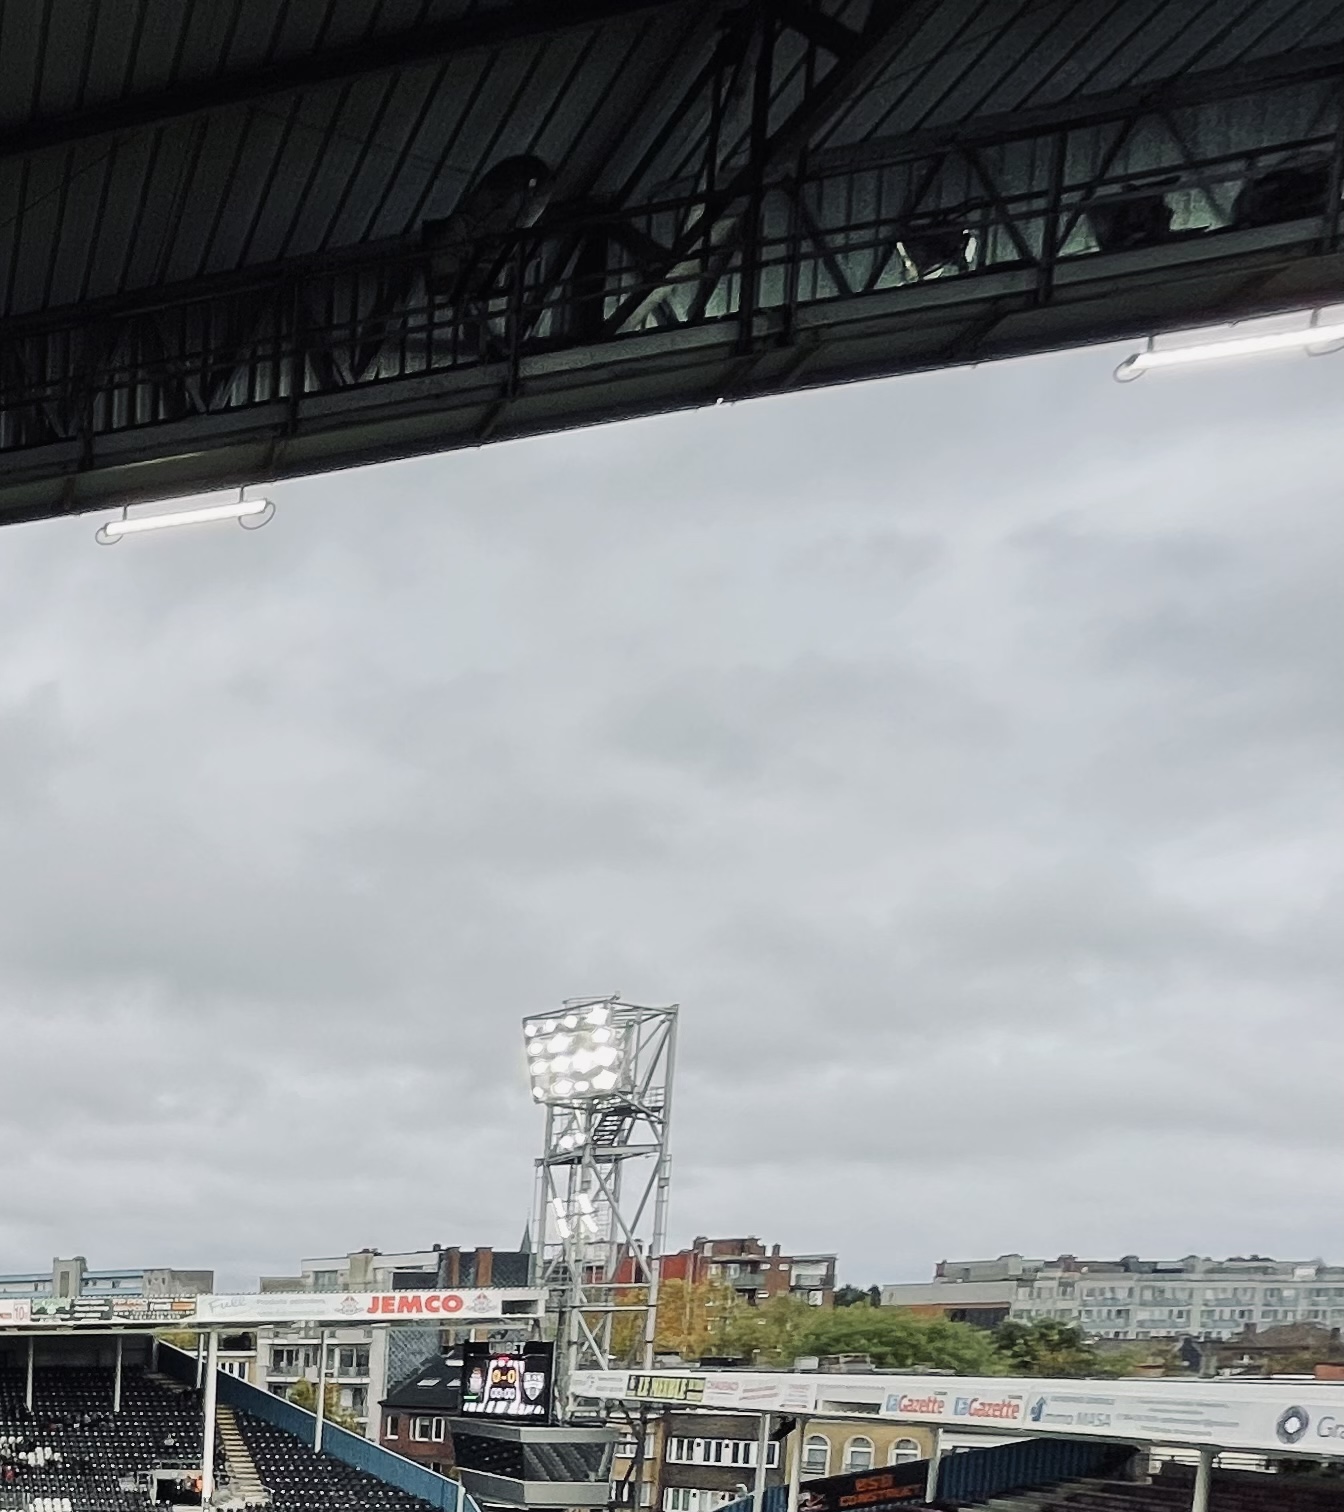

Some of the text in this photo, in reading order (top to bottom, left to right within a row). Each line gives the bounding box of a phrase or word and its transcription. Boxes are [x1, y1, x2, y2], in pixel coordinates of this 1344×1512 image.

[367, 1295, 463, 1313] JEMCO
[899, 1394, 945, 1414] Gazette
[969, 1397, 1020, 1419] Gazette
